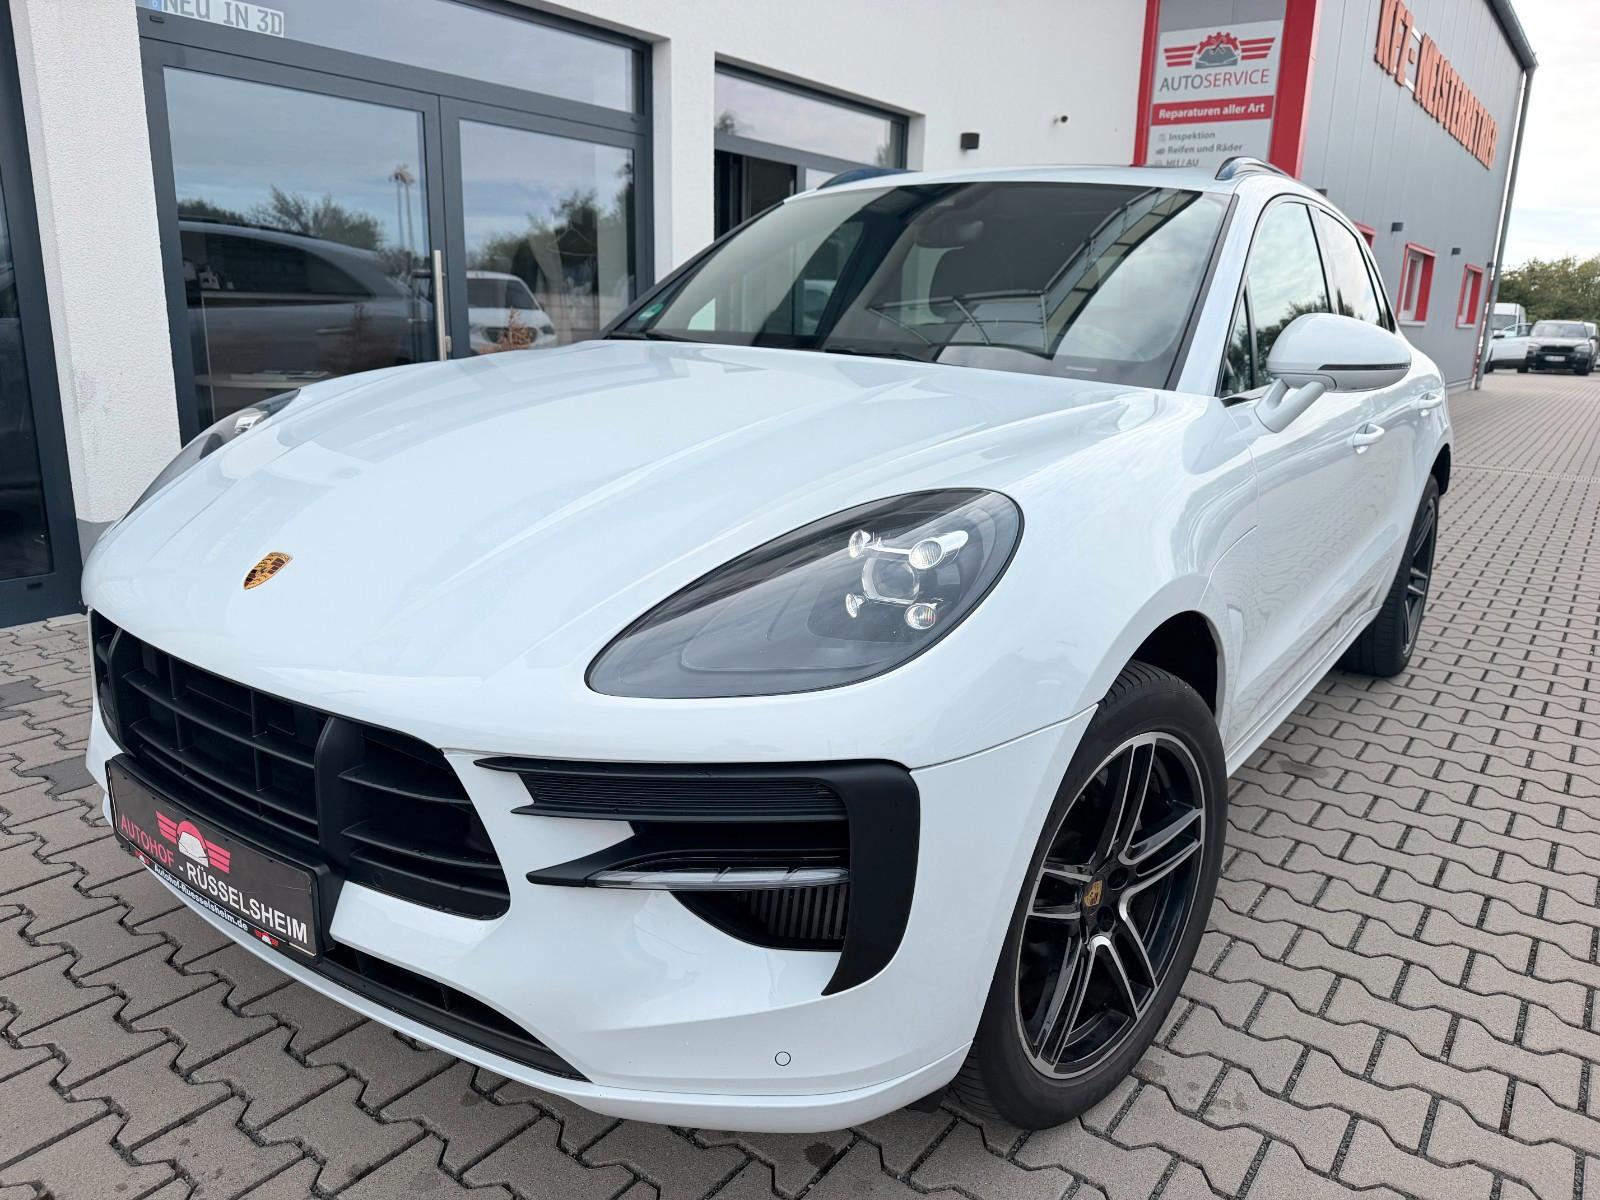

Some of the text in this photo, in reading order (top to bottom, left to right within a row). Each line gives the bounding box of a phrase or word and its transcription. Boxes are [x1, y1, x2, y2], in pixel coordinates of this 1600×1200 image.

[223, 1, 249, 28] IN
[256, 9, 282, 35] 3D
[1159, 68, 1270, 92] AUTOSERVICE
[1159, 103, 1265, 120] Reparaturen aller Art
[1168, 131, 1216, 142] Inspektion
[1167, 143, 1243, 154] Reifen und Räder
[121, 814, 174, 867] AUTOHOF
[186, 862, 308, 944] RÜSSELSHEIM
